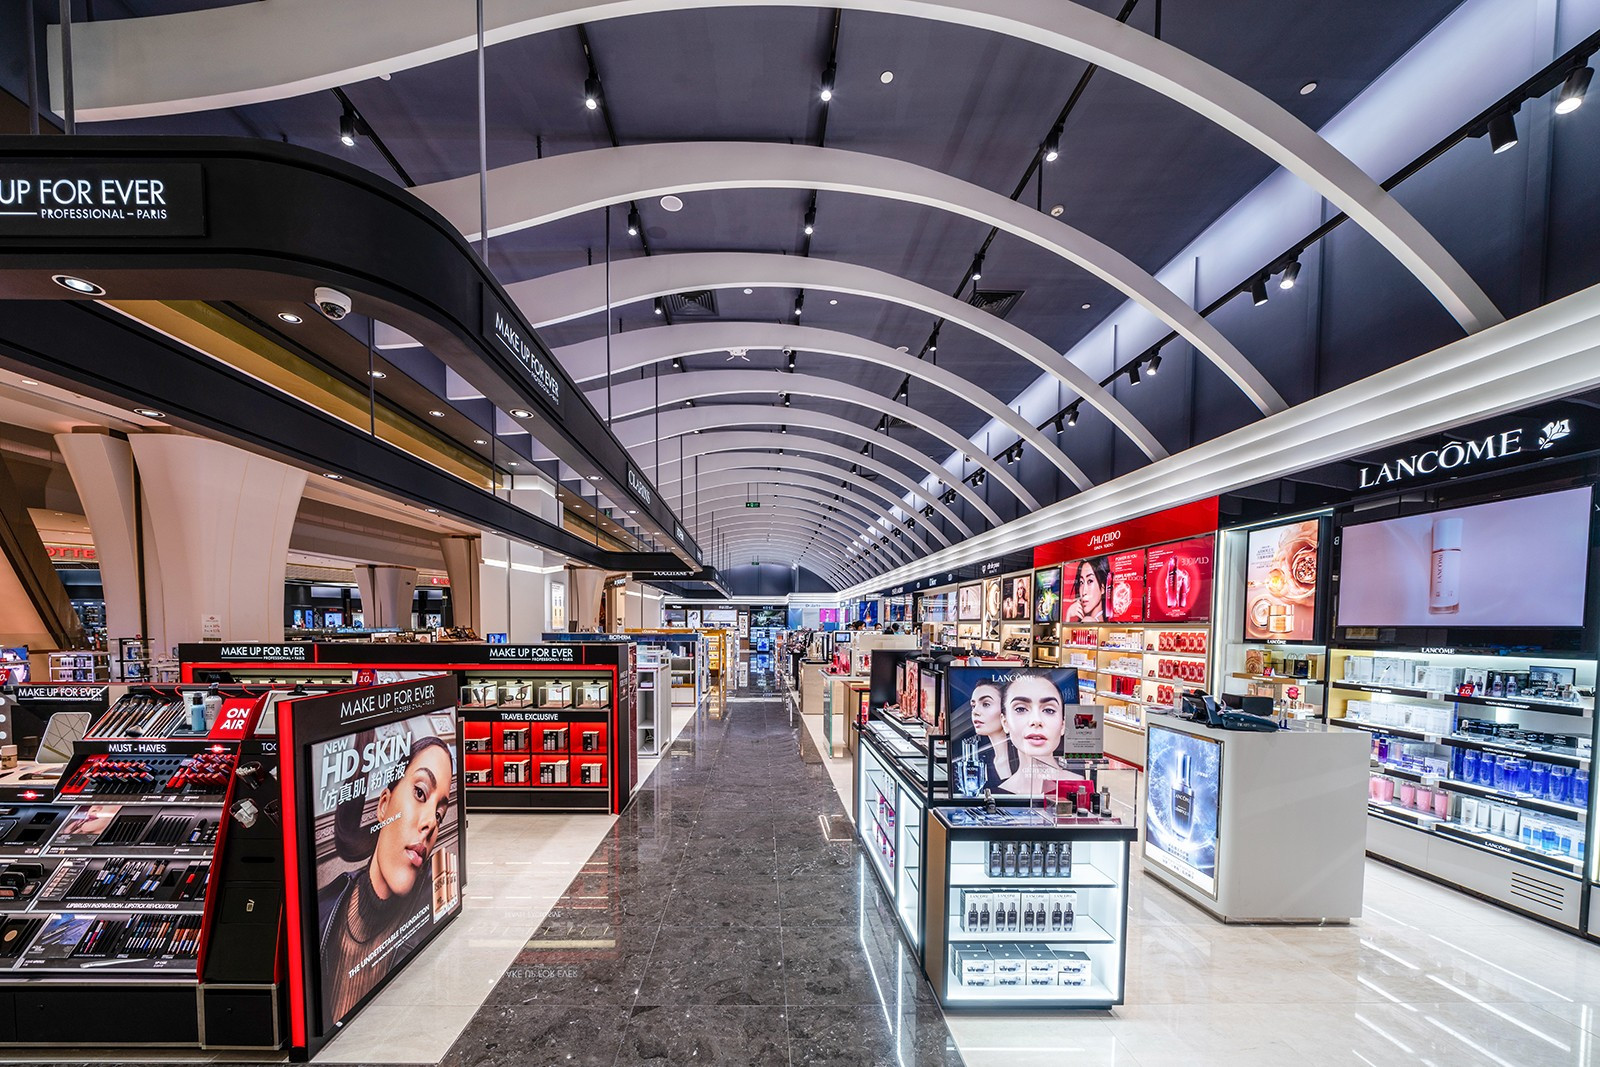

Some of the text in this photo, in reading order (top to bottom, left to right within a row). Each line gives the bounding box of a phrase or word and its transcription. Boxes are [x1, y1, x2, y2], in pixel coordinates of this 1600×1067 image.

[0, 179, 166, 205] UP FOR EVER
[41, 208, 167, 219] PROFESSIONAL PARIS
[495, 312, 559, 398] MAKE UP FOR EVER
[1359, 429, 1522, 488] LANCÔME
[628, 470, 650, 505] CLARINS
[1087, 530, 1121, 547] SHISEIDO
[221, 647, 305, 656] MAKE UP FOR EVER
[489, 648, 573, 657] MAKE UP FOR EVER
[18, 688, 102, 697] MAKE UP FOR EVER
[340, 684, 435, 718] MAKE UP FOR EVER
[227, 708, 249, 719] ON
[501, 713, 558, 721] TRAVEL EXCLUSIVE
[220, 719, 243, 730] AIR
[109, 744, 166, 752] MUST HAVES
[324, 739, 349, 756] NEW
[321, 731, 412, 788] HD SKIN
[370, 821, 386, 834] FOCUS
[386, 817, 394, 827] ON
[349, 964, 361, 979] THE
[361, 928, 399, 968] UNDETECTABLE
[399, 904, 430, 936] FOUNDATION
